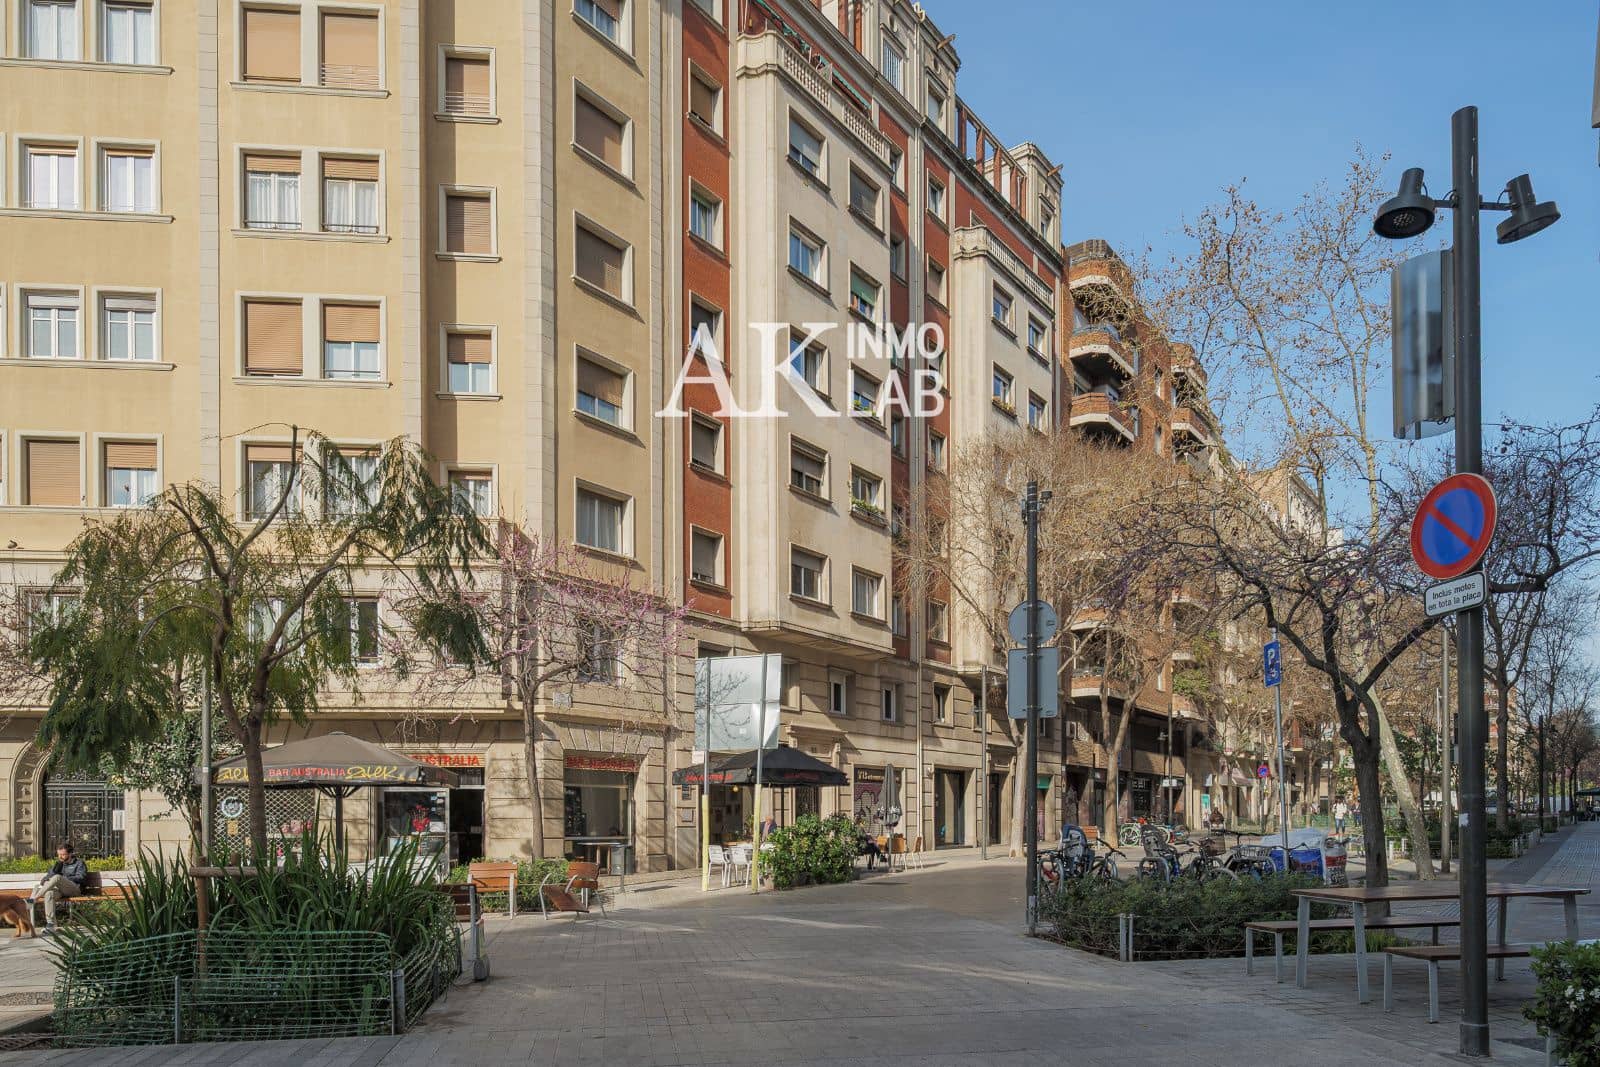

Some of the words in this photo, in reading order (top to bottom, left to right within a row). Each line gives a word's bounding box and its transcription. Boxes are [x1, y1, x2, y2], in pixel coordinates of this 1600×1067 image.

[1454, 582, 1476, 594] motos
[1438, 599, 1452, 608] tota
[269, 767, 288, 777] BAR
[290, 767, 346, 777] AUSTRALIA
